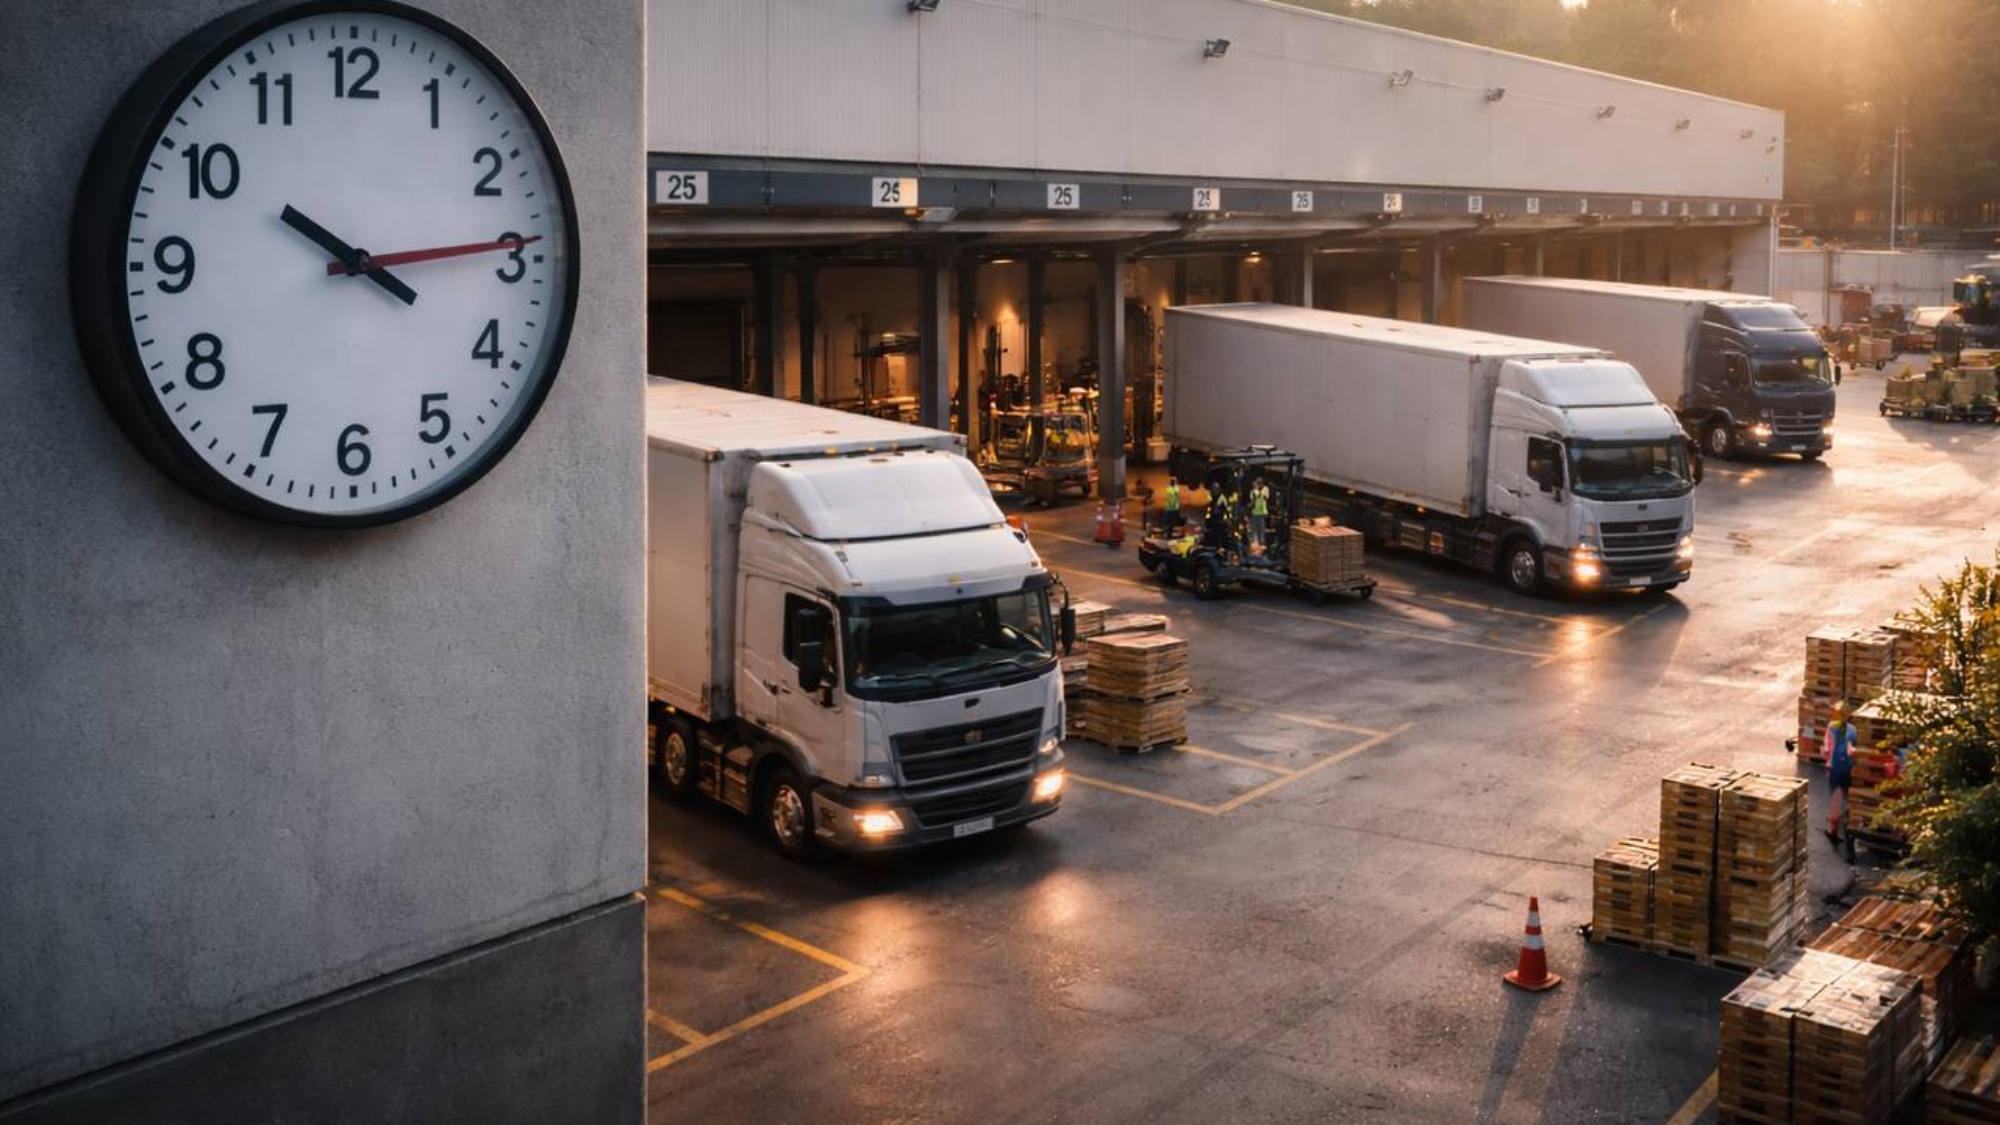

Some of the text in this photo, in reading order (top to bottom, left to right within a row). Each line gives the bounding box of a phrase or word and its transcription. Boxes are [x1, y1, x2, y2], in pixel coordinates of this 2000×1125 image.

[250, 71, 293, 126] 11
[328, 46, 380, 99] 12
[423, 78, 440, 129] 1
[181, 143, 240, 200] 10
[473, 147, 503, 197] 2
[668, 175, 696, 199] 25
[880, 181, 901, 202] 25
[1054, 186, 1072, 205] 25
[153, 235, 195, 294] 9
[496, 231, 526, 283] 3
[185, 332, 225, 390] 8
[471, 319, 504, 369] 4
[252, 403, 288, 458] 7
[419, 393, 451, 444] 5
[337, 423, 371, 476] 6
